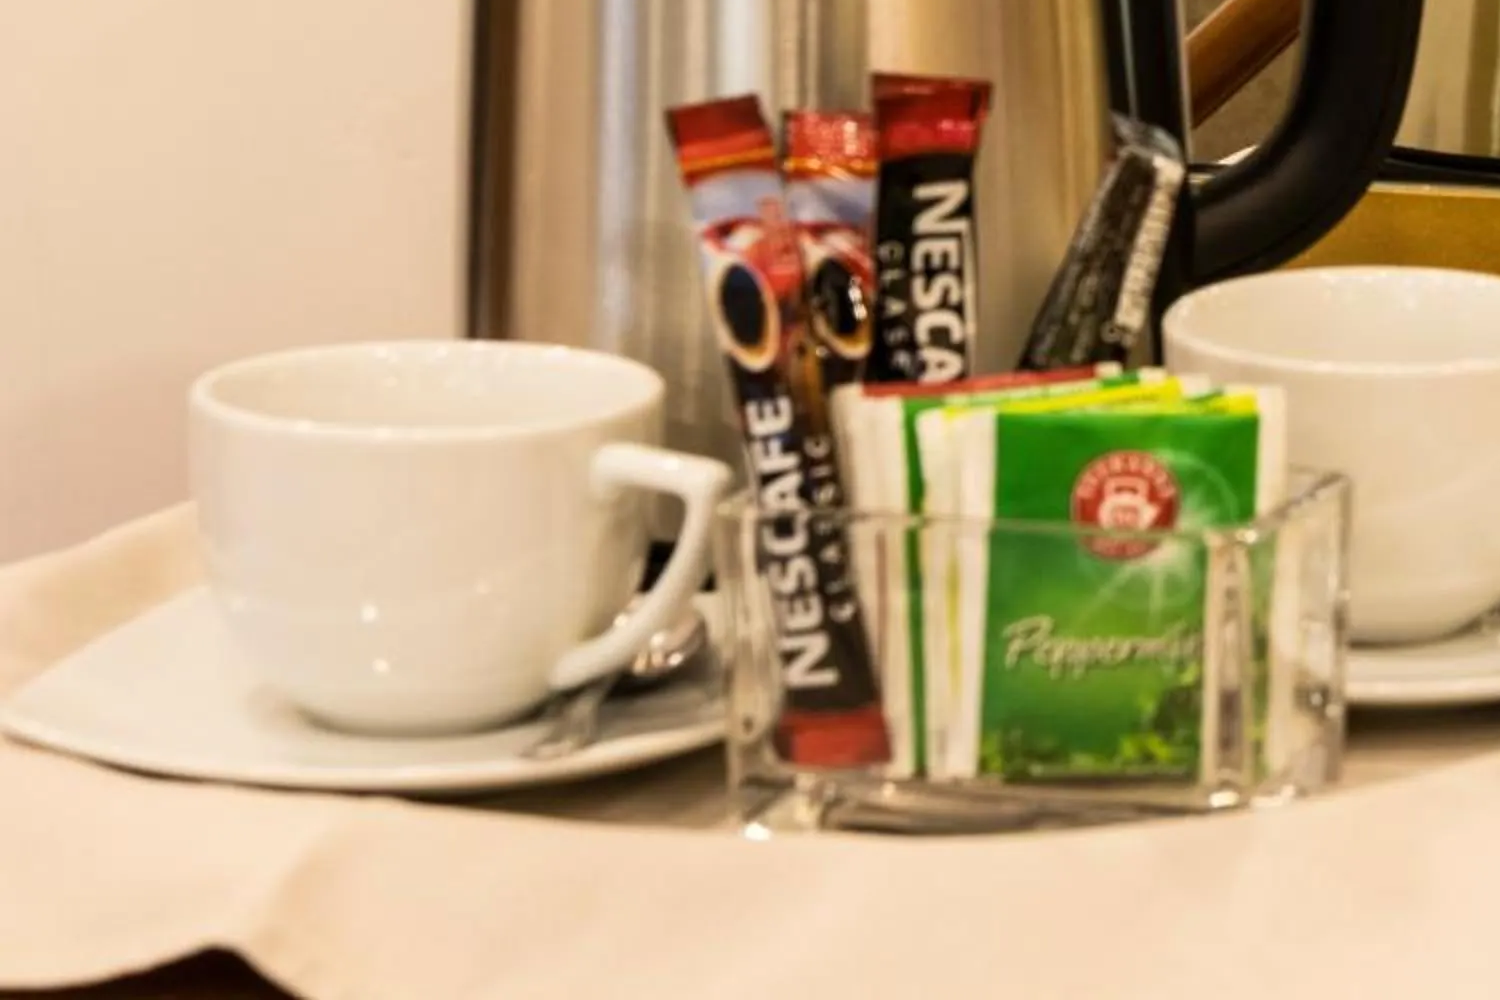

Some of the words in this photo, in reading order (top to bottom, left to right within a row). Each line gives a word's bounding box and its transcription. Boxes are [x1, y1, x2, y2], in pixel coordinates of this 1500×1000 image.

[877, 238, 913, 378] CLASS
[910, 179, 973, 383] NESCA
[804, 437, 853, 624] CLASSIC
